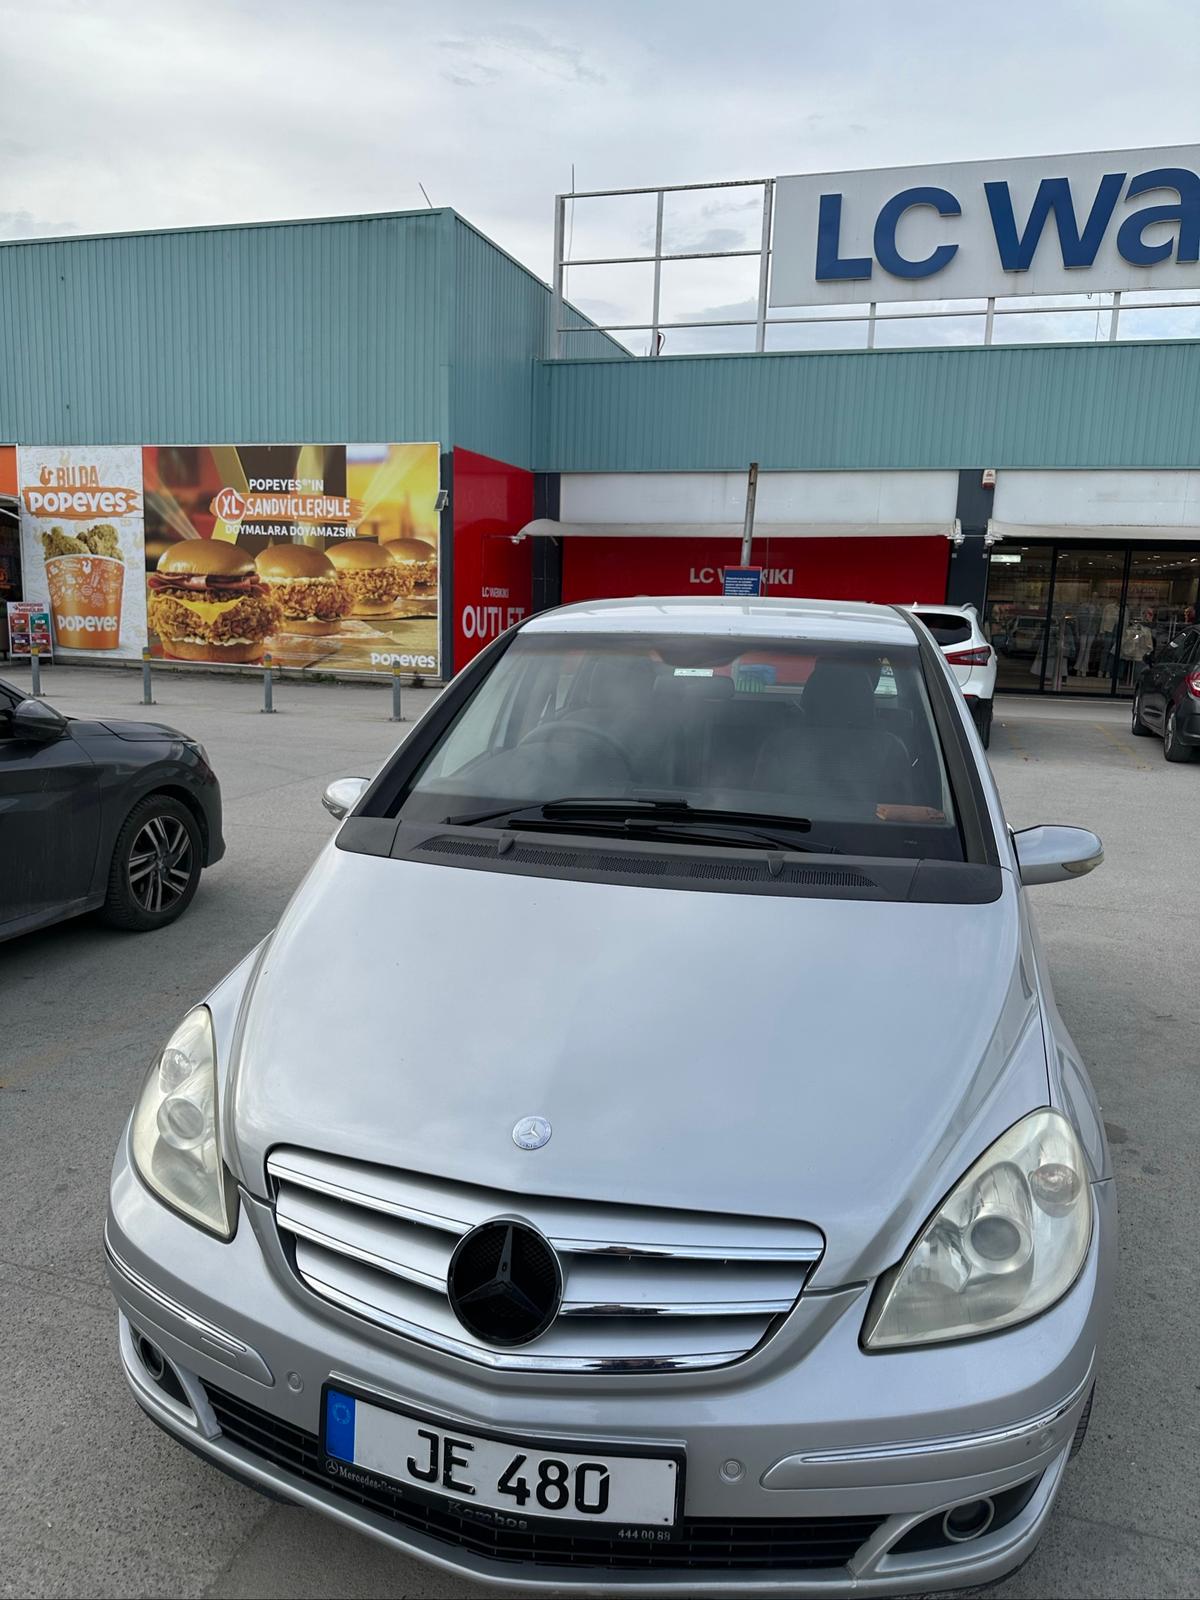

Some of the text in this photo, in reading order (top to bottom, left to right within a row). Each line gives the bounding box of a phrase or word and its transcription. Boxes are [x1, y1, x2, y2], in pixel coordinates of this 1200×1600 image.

[815, 186, 961, 281] LC
[221, 494, 240, 517] XL
[225, 524, 356, 537] DOYMALARA DOYAMAZSIN
[689, 567, 715, 584] LC
[462, 604, 525, 638] OUTLET
[406, 1428, 610, 1514] JE 480
[617, 1529, 639, 1539] 444
[641, 1530, 655, 1540] 00
